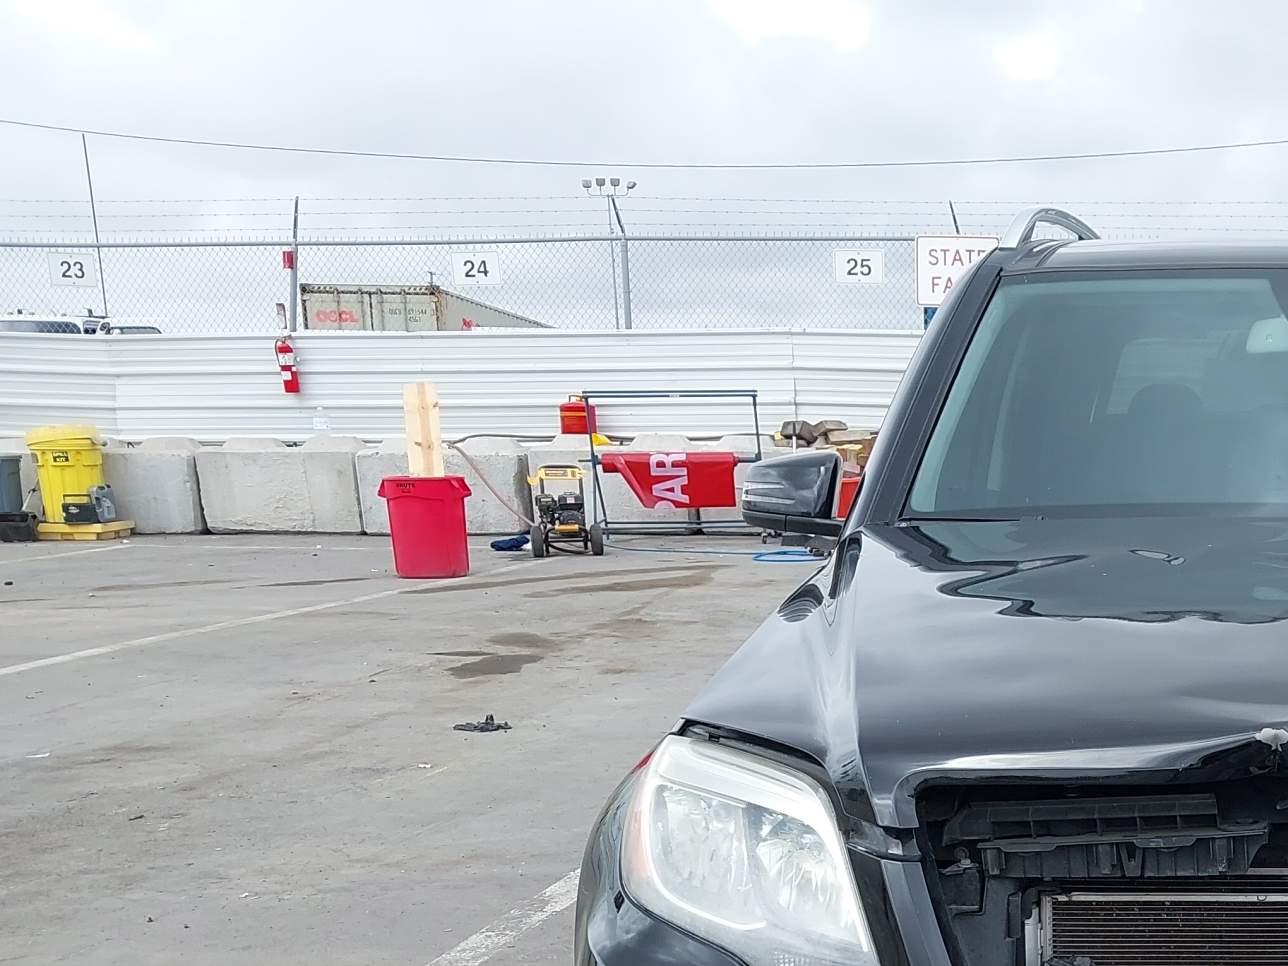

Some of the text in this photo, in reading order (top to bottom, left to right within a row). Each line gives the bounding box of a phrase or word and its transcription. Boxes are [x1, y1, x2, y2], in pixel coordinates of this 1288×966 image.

[60, 260, 85, 279] 23
[463, 259, 489, 278] 24
[846, 258, 872, 277] 25
